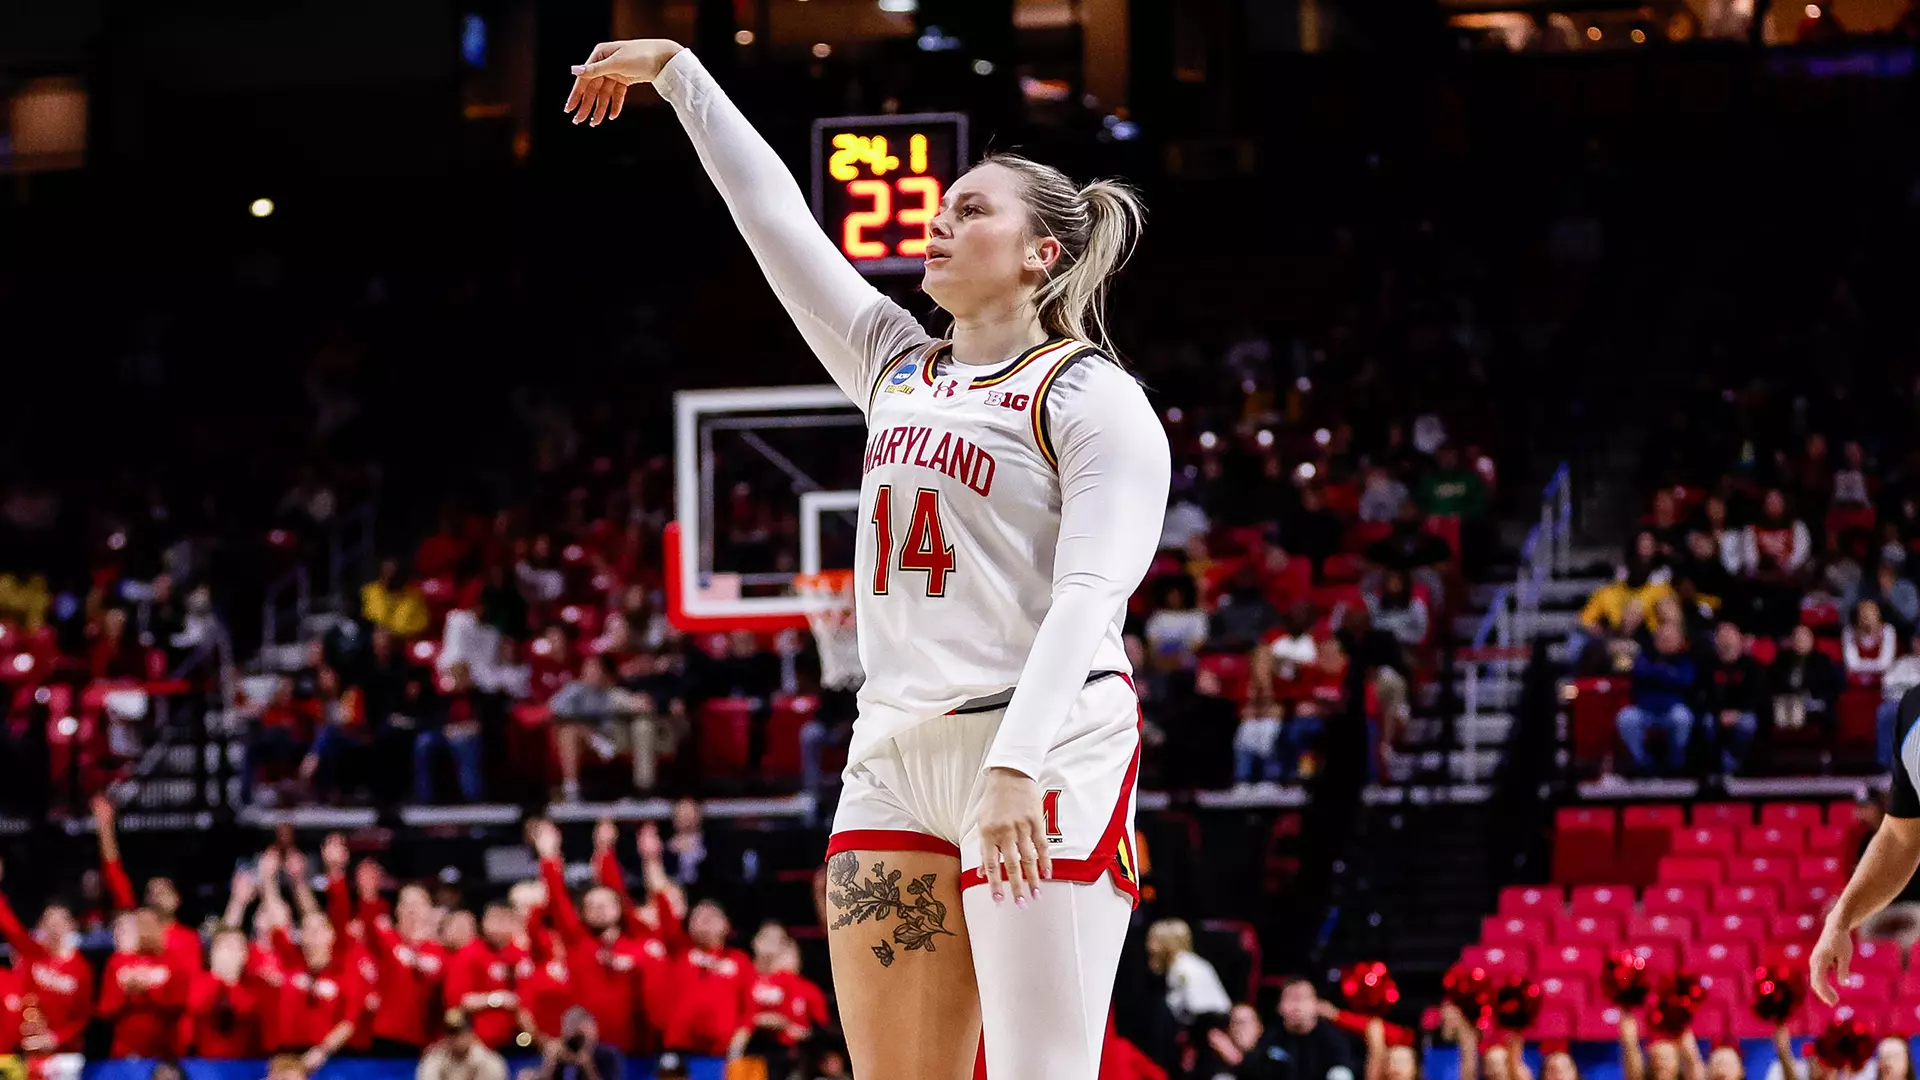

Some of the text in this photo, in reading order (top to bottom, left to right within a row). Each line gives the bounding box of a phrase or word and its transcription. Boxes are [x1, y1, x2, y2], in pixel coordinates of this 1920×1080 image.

[829, 133, 928, 181] 24.1
[844, 176, 941, 259] 23
[871, 485, 956, 597] 14
